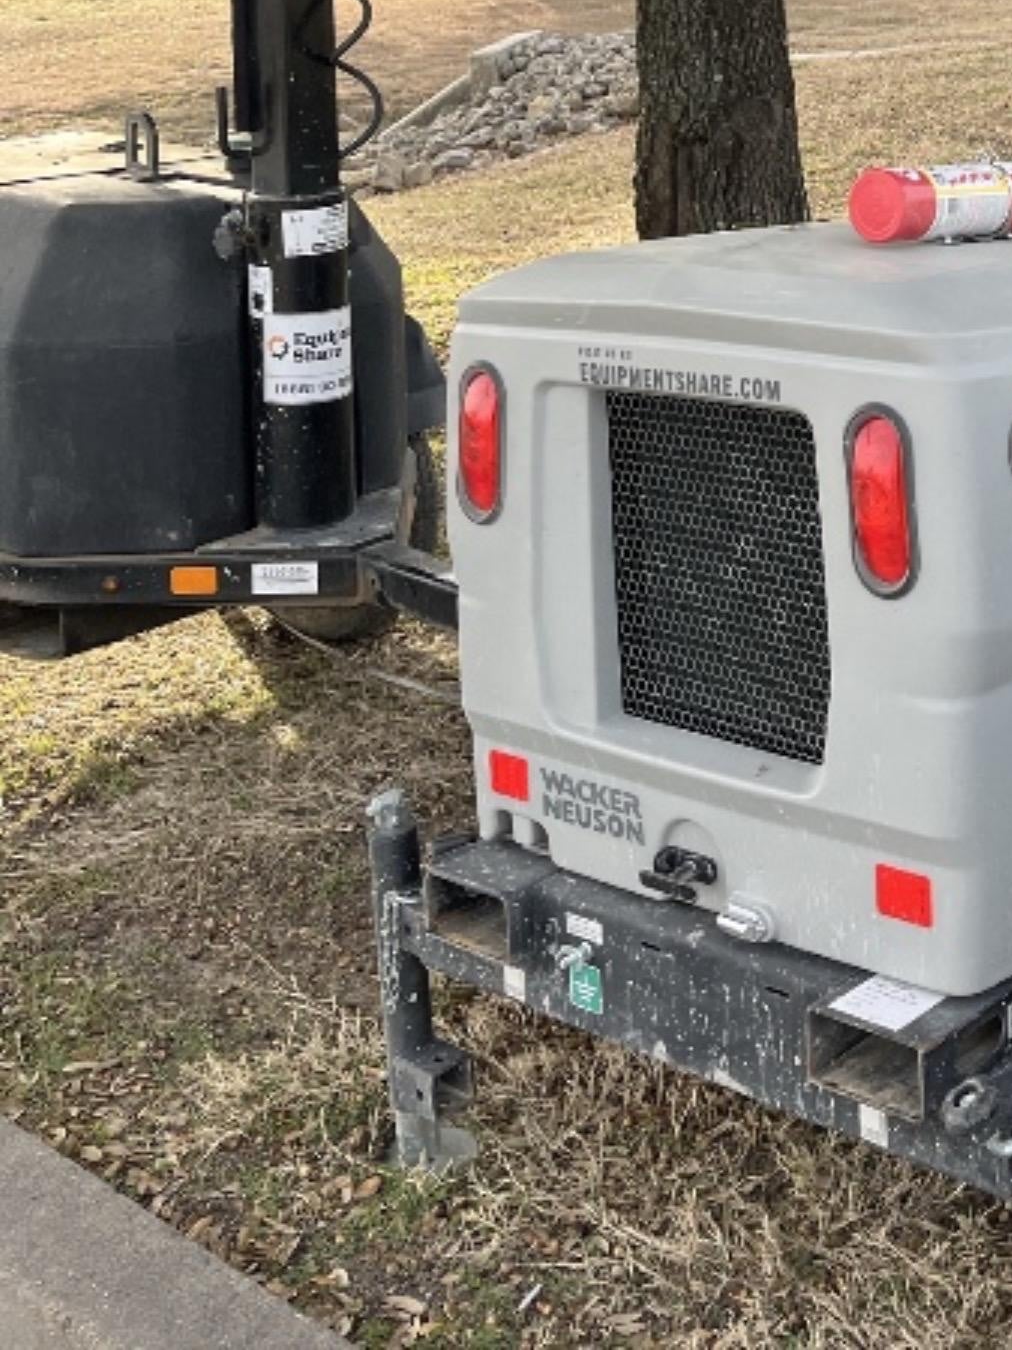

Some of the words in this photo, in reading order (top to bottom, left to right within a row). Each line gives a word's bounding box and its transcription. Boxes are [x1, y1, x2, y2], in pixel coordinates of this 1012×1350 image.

[579, 361, 782, 402] EQUIPMENTSHARE.COM
[539, 766, 643, 820] WACKER
[542, 793, 646, 847] NEUSON
